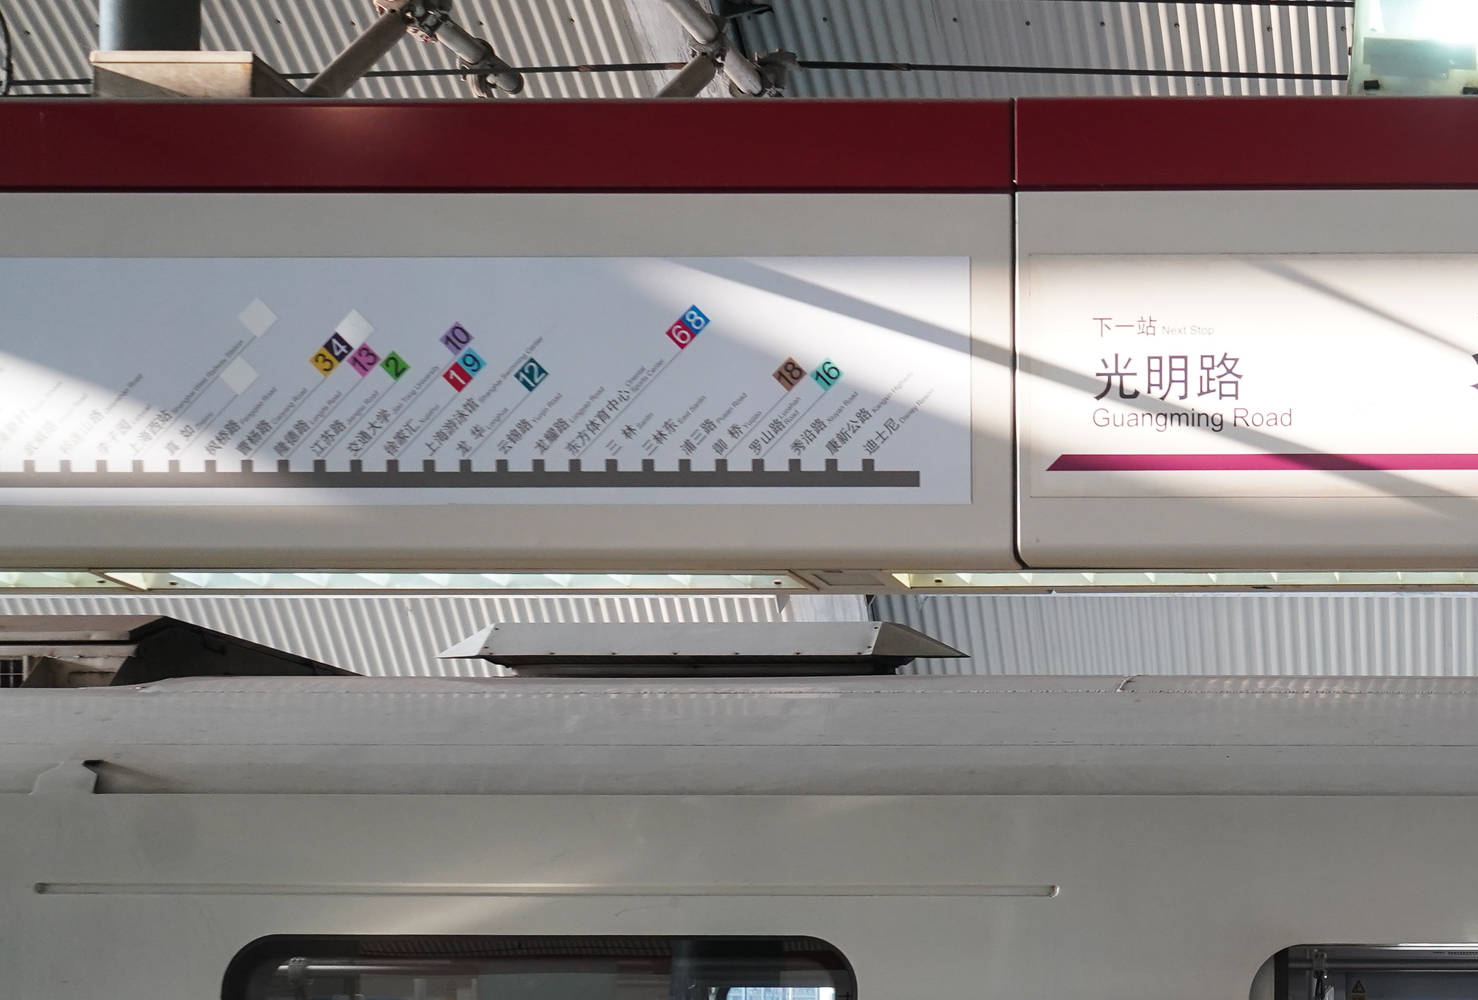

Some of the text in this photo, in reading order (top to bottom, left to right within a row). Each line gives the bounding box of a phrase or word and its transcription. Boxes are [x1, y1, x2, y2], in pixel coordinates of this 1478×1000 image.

[671, 324, 691, 344] 6
[685, 310, 705, 330] 8
[1092, 316, 1157, 337] 下一站
[1162, 325, 1215, 336] Next Stop
[328, 337, 349, 358] 4
[442, 325, 471, 354] 10
[314, 352, 334, 372] 3
[349, 345, 379, 375] 13
[384, 355, 405, 376] 2
[462, 353, 482, 373] 9
[776, 360, 804, 388] 18
[448, 371, 465, 387] 1
[517, 361, 545, 389] 12
[812, 360, 842, 389] 16
[1094, 352, 1244, 402] 光明路
[565, 387, 632, 455] 东方体育中心
[824, 407, 872, 455] 康新公路
[1092, 407, 1293, 432] Guangming Road
[605, 423, 638, 455] 三林
[641, 418, 678, 455] 三林东
[748, 417, 786, 455] 罗山路
[789, 418, 827, 455] 秀沿路
[863, 418, 900, 455] 迪士尼
